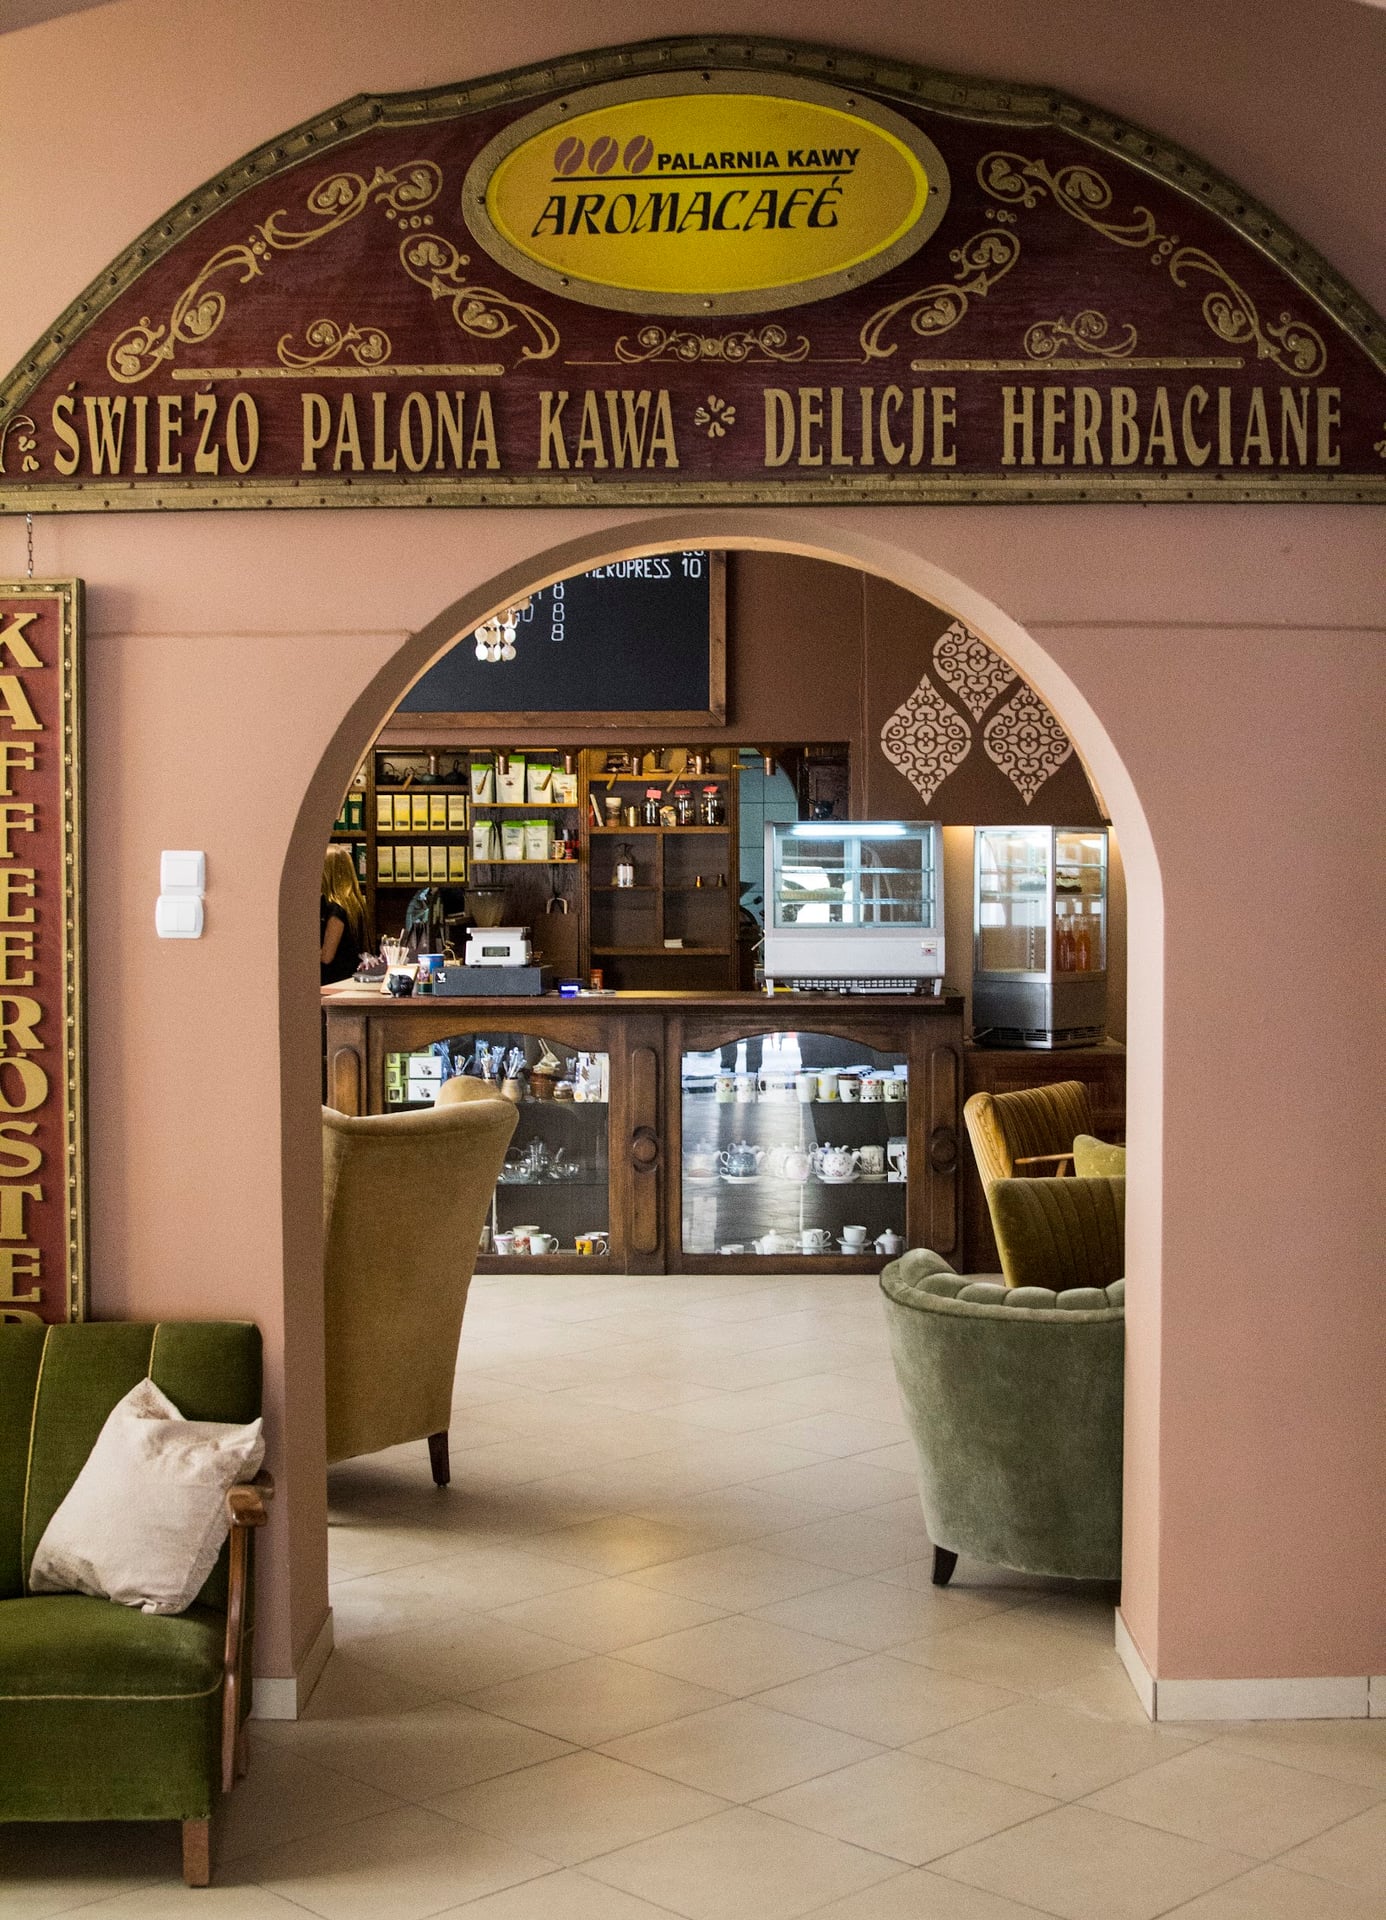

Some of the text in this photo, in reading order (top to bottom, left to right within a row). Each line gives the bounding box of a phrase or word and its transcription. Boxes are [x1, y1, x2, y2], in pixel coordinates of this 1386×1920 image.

[658, 148, 860, 171] PALARNIA KAWY
[531, 177, 843, 236] AROMACAFÉ
[301, 389, 500, 473] PALONA
[538, 388, 680, 470] KAWA
[763, 384, 1342, 468] DELICJE HERBACIANE
[681, 557, 702, 578] 10
[552, 602, 565, 622] 8
[551, 623, 564, 642] 8
